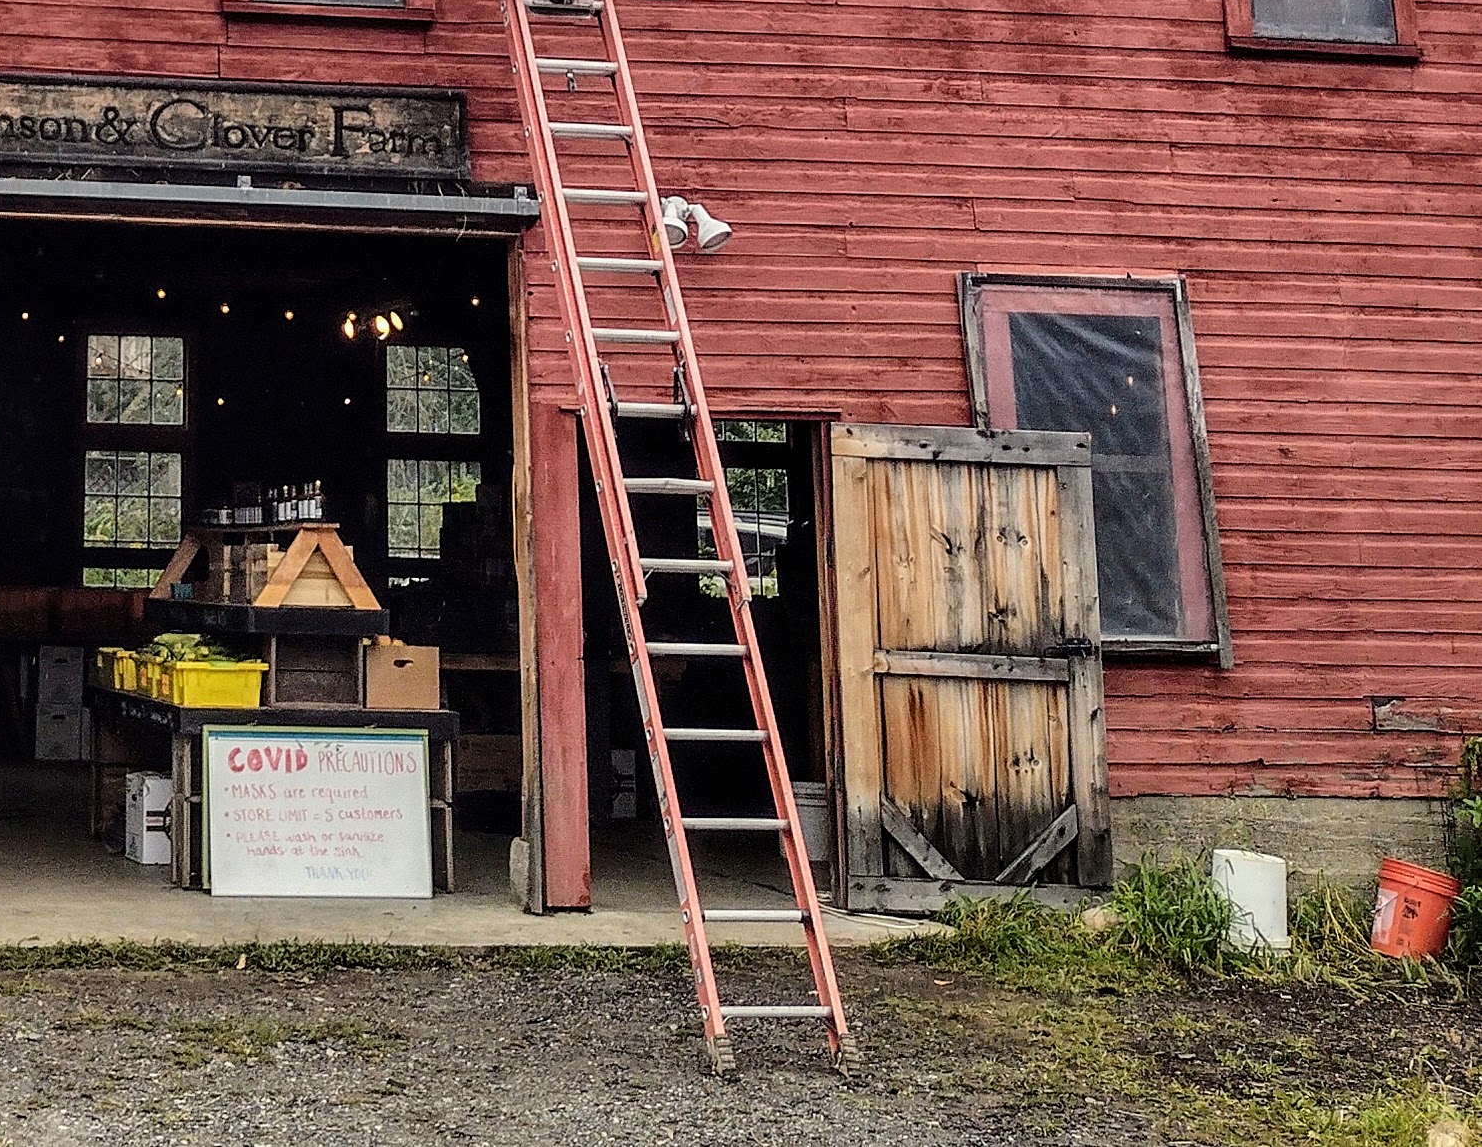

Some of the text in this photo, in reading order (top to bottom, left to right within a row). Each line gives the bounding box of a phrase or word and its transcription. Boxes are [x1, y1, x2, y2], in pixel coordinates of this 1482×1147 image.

[150, 99, 315, 152] Clover
[332, 105, 442, 156] Farm
[227, 746, 418, 775] COVID PRECAUTIONS
[232, 783, 368, 804] MASKS are required
[233, 808, 271, 822] STORE
[279, 808, 308, 822] LIMIT
[338, 808, 404, 821] customers
[235, 830, 280, 843] PLEASE
[285, 831, 317, 842] wash
[321, 832, 334, 841] or
[246, 843, 362, 858] hands at the sink
[304, 865, 369, 881] THANK YOU
